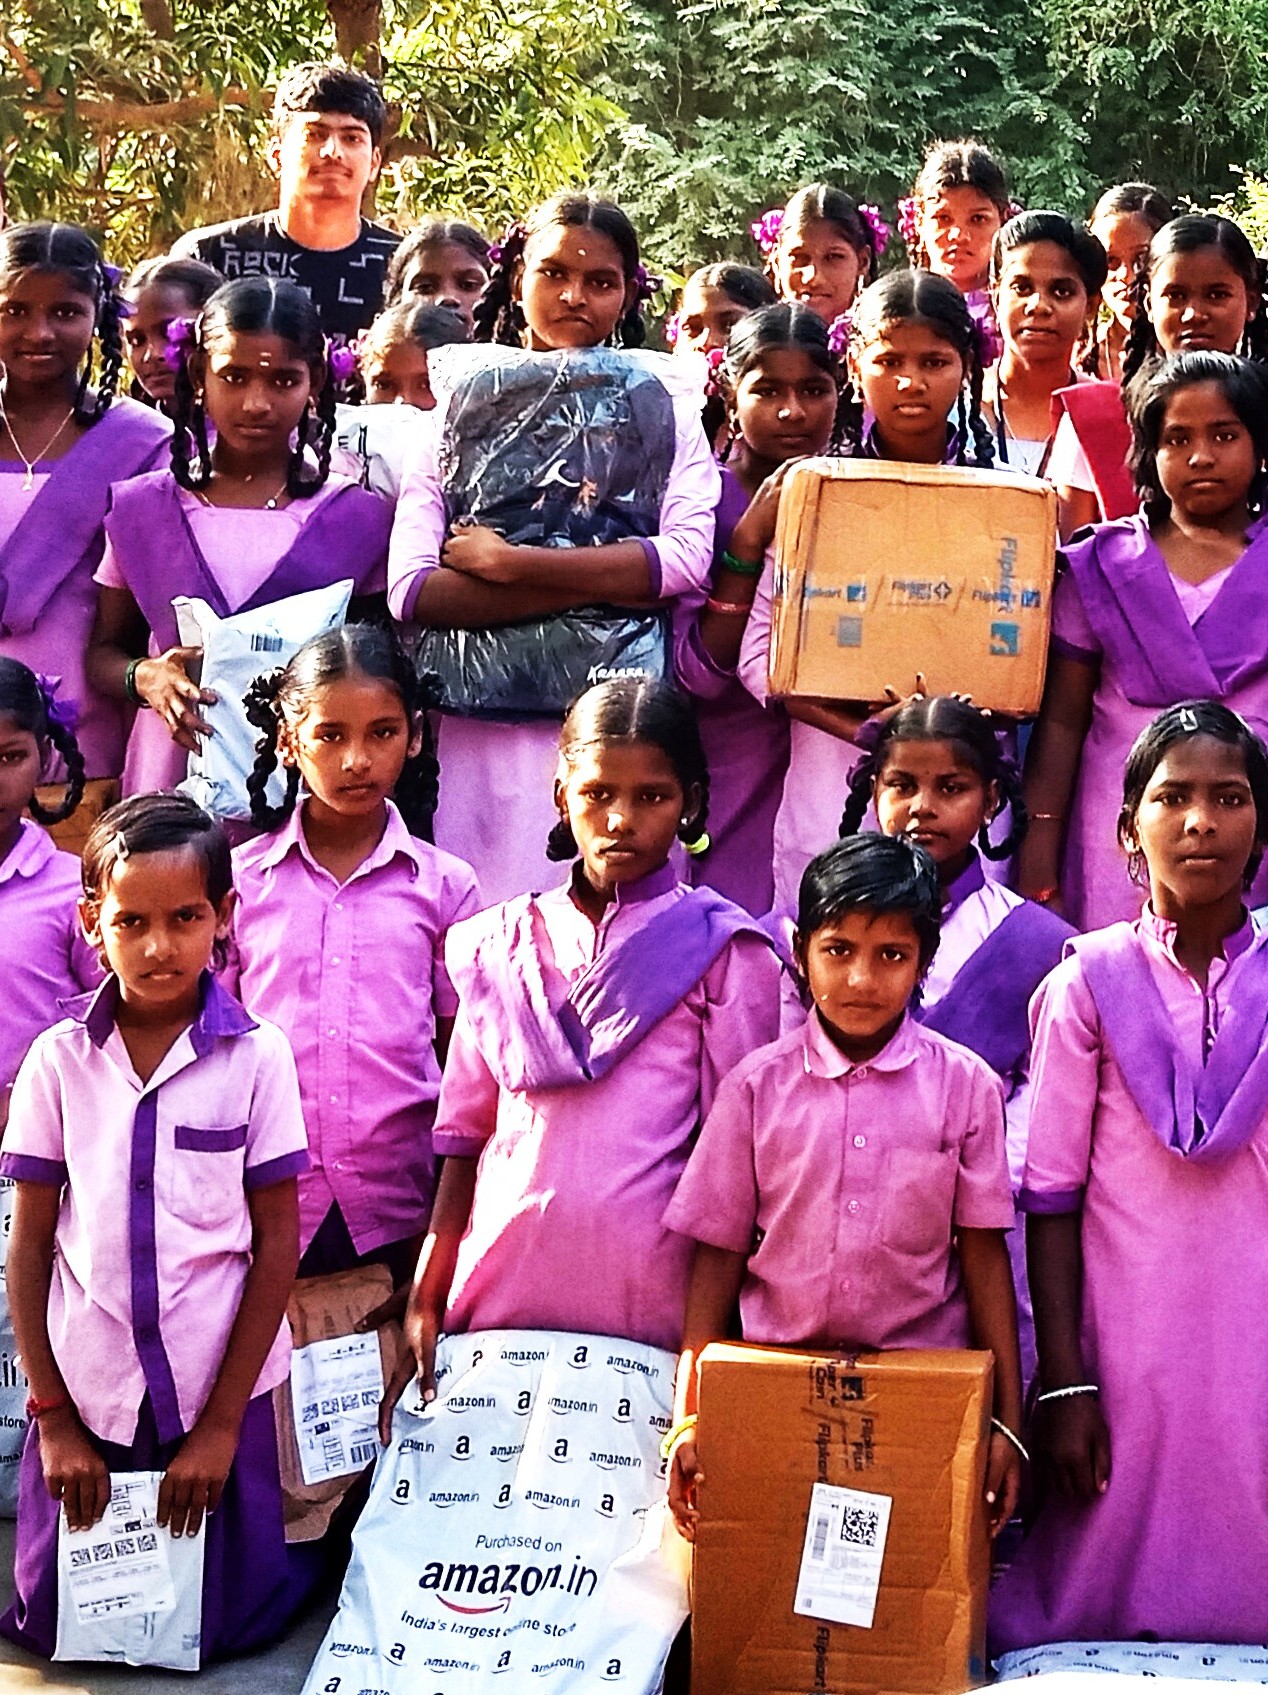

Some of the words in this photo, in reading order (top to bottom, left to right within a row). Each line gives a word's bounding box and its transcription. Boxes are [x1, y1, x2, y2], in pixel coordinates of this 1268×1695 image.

[573, 1346, 588, 1363] a
[517, 1391, 531, 1410] a
[617, 1398, 631, 1417] a
[456, 1435, 470, 1454] a
[554, 1438, 568, 1457] a
[395, 1479, 410, 1498] a
[498, 1484, 511, 1502] a
[601, 1494, 615, 1512] a
[475, 1534, 542, 1550] Purchased
[545, 1541, 563, 1552] on
[419, 1554, 598, 1597] amazon.in
[401, 1610, 447, 1631] India's
[450, 1622, 501, 1639] largest
[390, 1643, 406, 1661] a
[498, 1650, 512, 1668] a
[606, 1659, 622, 1675] a
[324, 1677, 342, 1693] a
